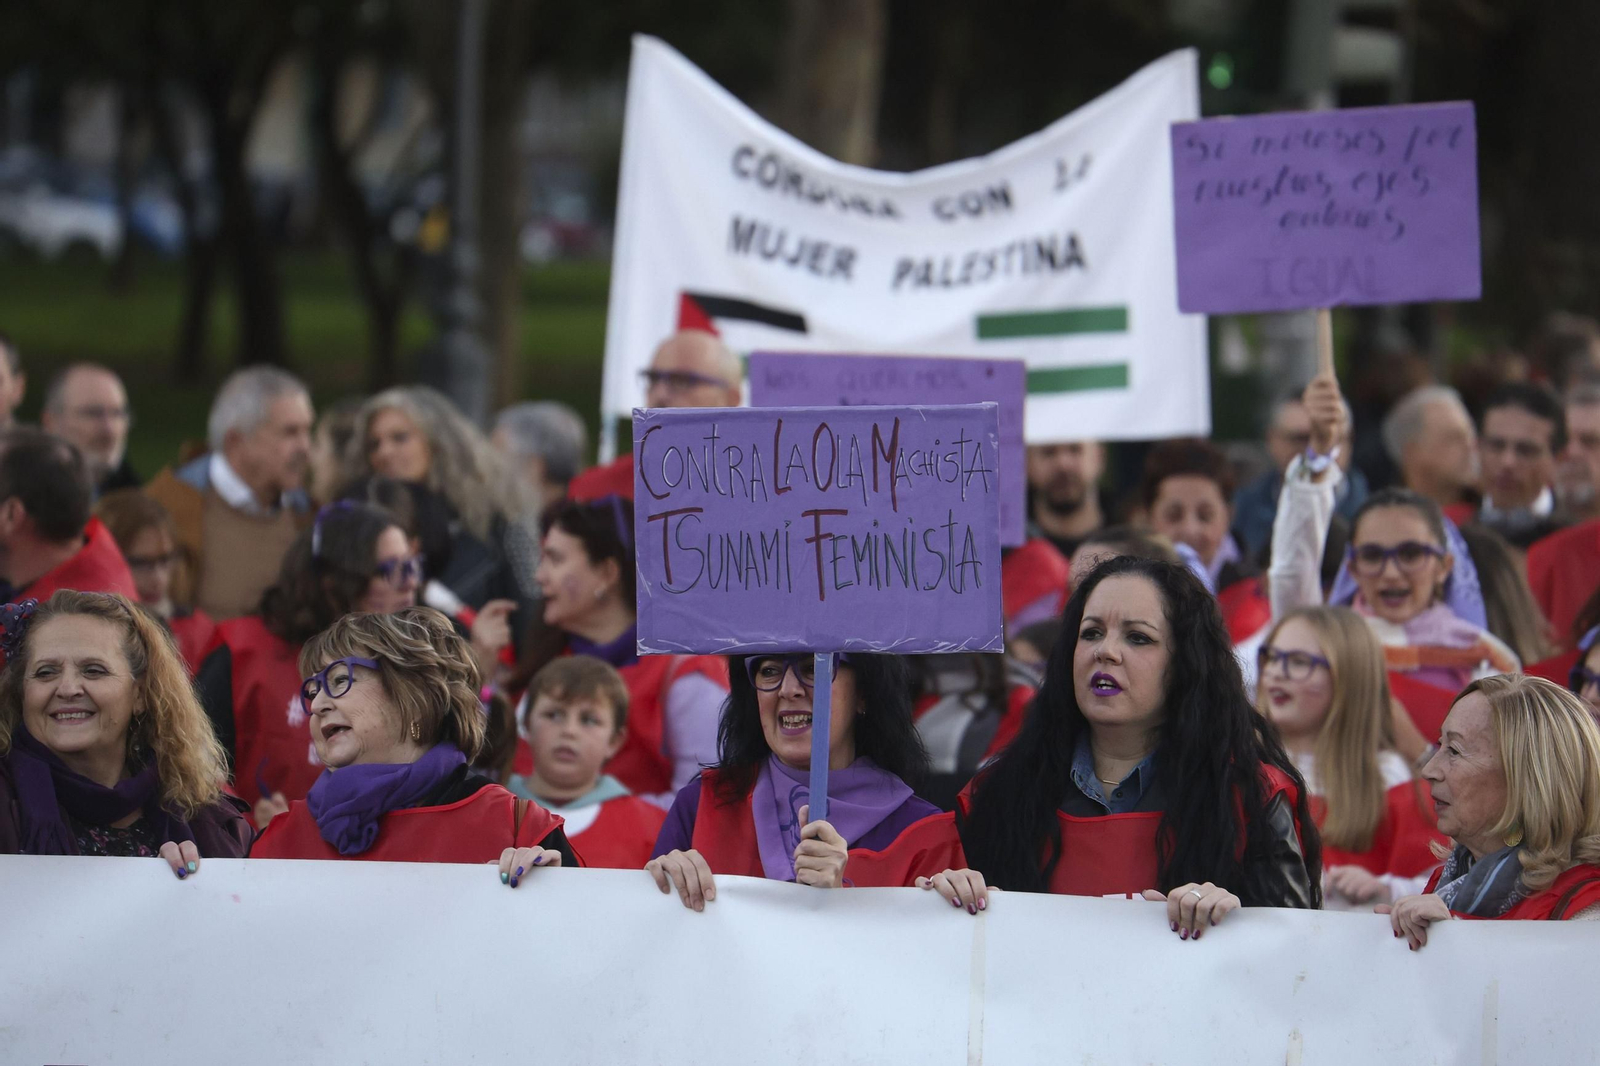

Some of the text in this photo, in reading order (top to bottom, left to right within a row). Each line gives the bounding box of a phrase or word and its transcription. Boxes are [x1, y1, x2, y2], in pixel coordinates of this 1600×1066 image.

[932, 178, 1013, 223] CON
[727, 215, 1087, 291] MUJER PALESTINA
[773, 418, 810, 496] LA
[811, 422, 868, 507] OLA
